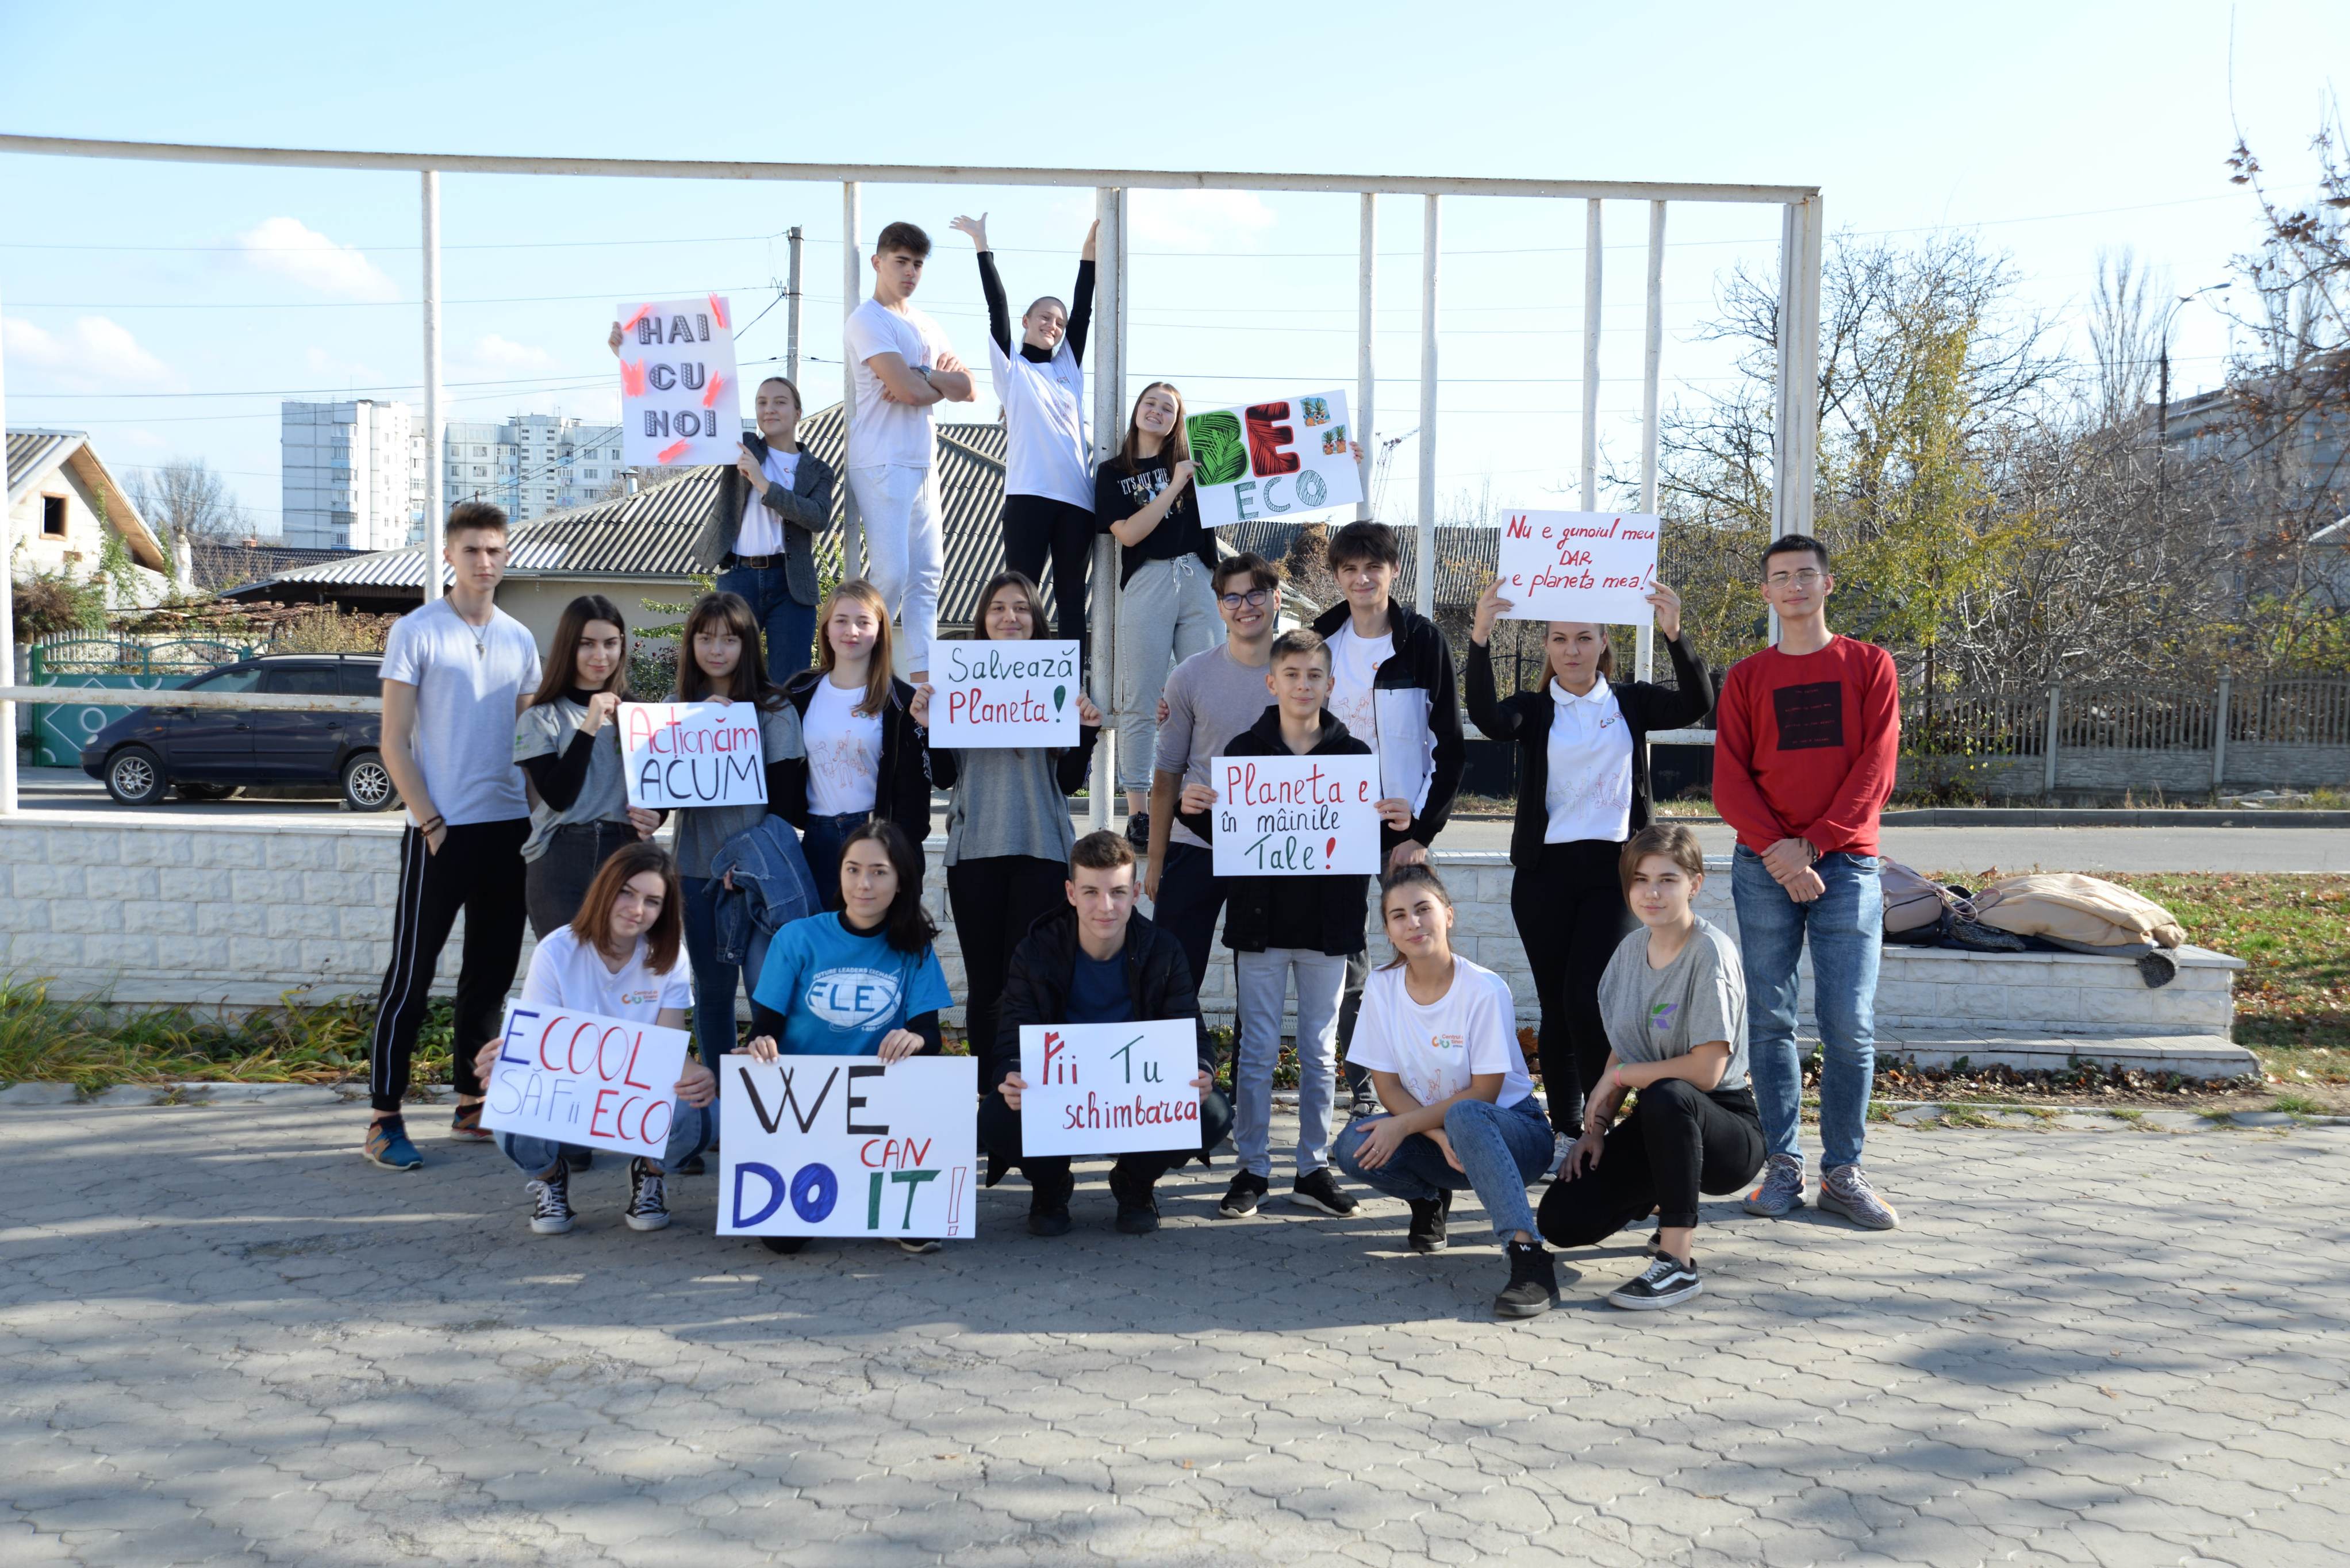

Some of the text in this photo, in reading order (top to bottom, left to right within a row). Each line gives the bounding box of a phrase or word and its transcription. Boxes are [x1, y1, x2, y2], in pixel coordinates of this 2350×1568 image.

[637, 314, 711, 345] HAI
[649, 362, 705, 390] CU
[644, 410, 716, 437] NOI
[1185, 401, 1301, 487] BE
[1138, 472, 1151, 487] HIT
[1153, 468, 1170, 484] THE
[1234, 469, 1327, 521] ECO
[1507, 515, 1654, 549] Nu e gunoiul meu
[1512, 563, 1654, 597] e planeta mea!
[949, 647, 1076, 682] Salvează
[640, 755, 763, 802] ACUM
[1228, 763, 1369, 806] Planeta e
[1221, 804, 1340, 832] în mâinile
[813, 968, 837, 980] FUTURE
[808, 981, 898, 1012] FLEX
[1042, 1031, 1164, 1085] Fii Tu
[590, 1089, 672, 1144] ECO
[738, 1065, 890, 1135] WE
[1063, 1091, 1198, 1129] schimbarea
[860, 1137, 931, 1170] CAN
[732, 1162, 838, 1228] DO
